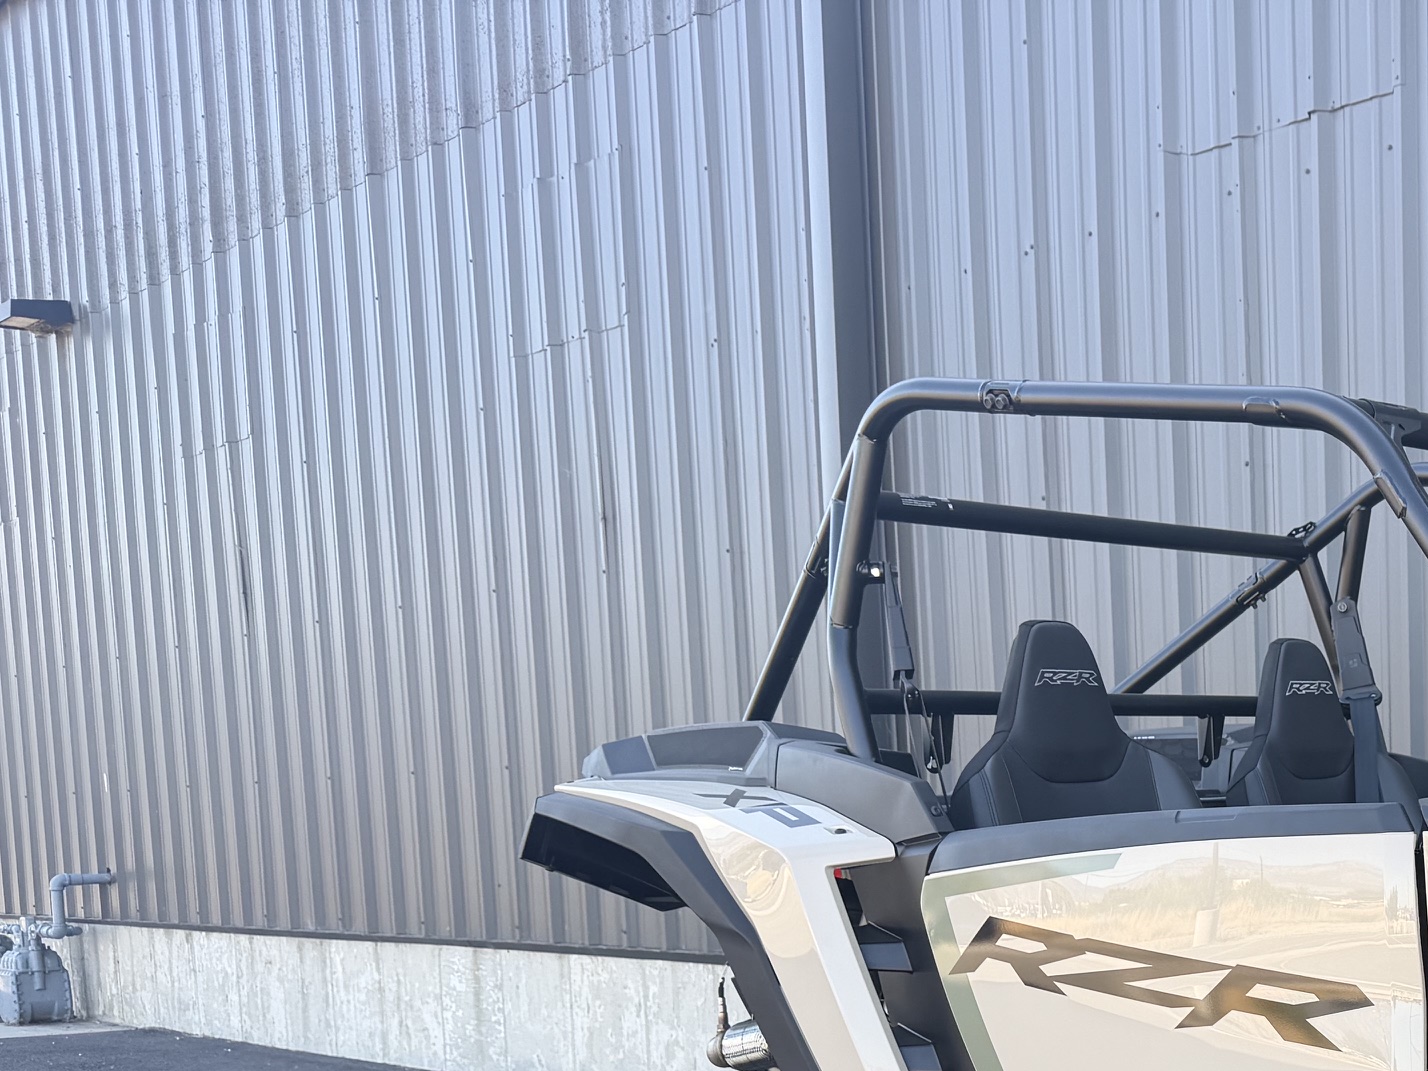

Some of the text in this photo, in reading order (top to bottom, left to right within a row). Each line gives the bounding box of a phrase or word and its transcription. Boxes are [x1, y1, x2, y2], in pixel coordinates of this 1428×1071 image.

[1034, 668, 1099, 686] RZR
[1285, 680, 1334, 696] RZR
[948, 916, 1375, 1052] RZR
